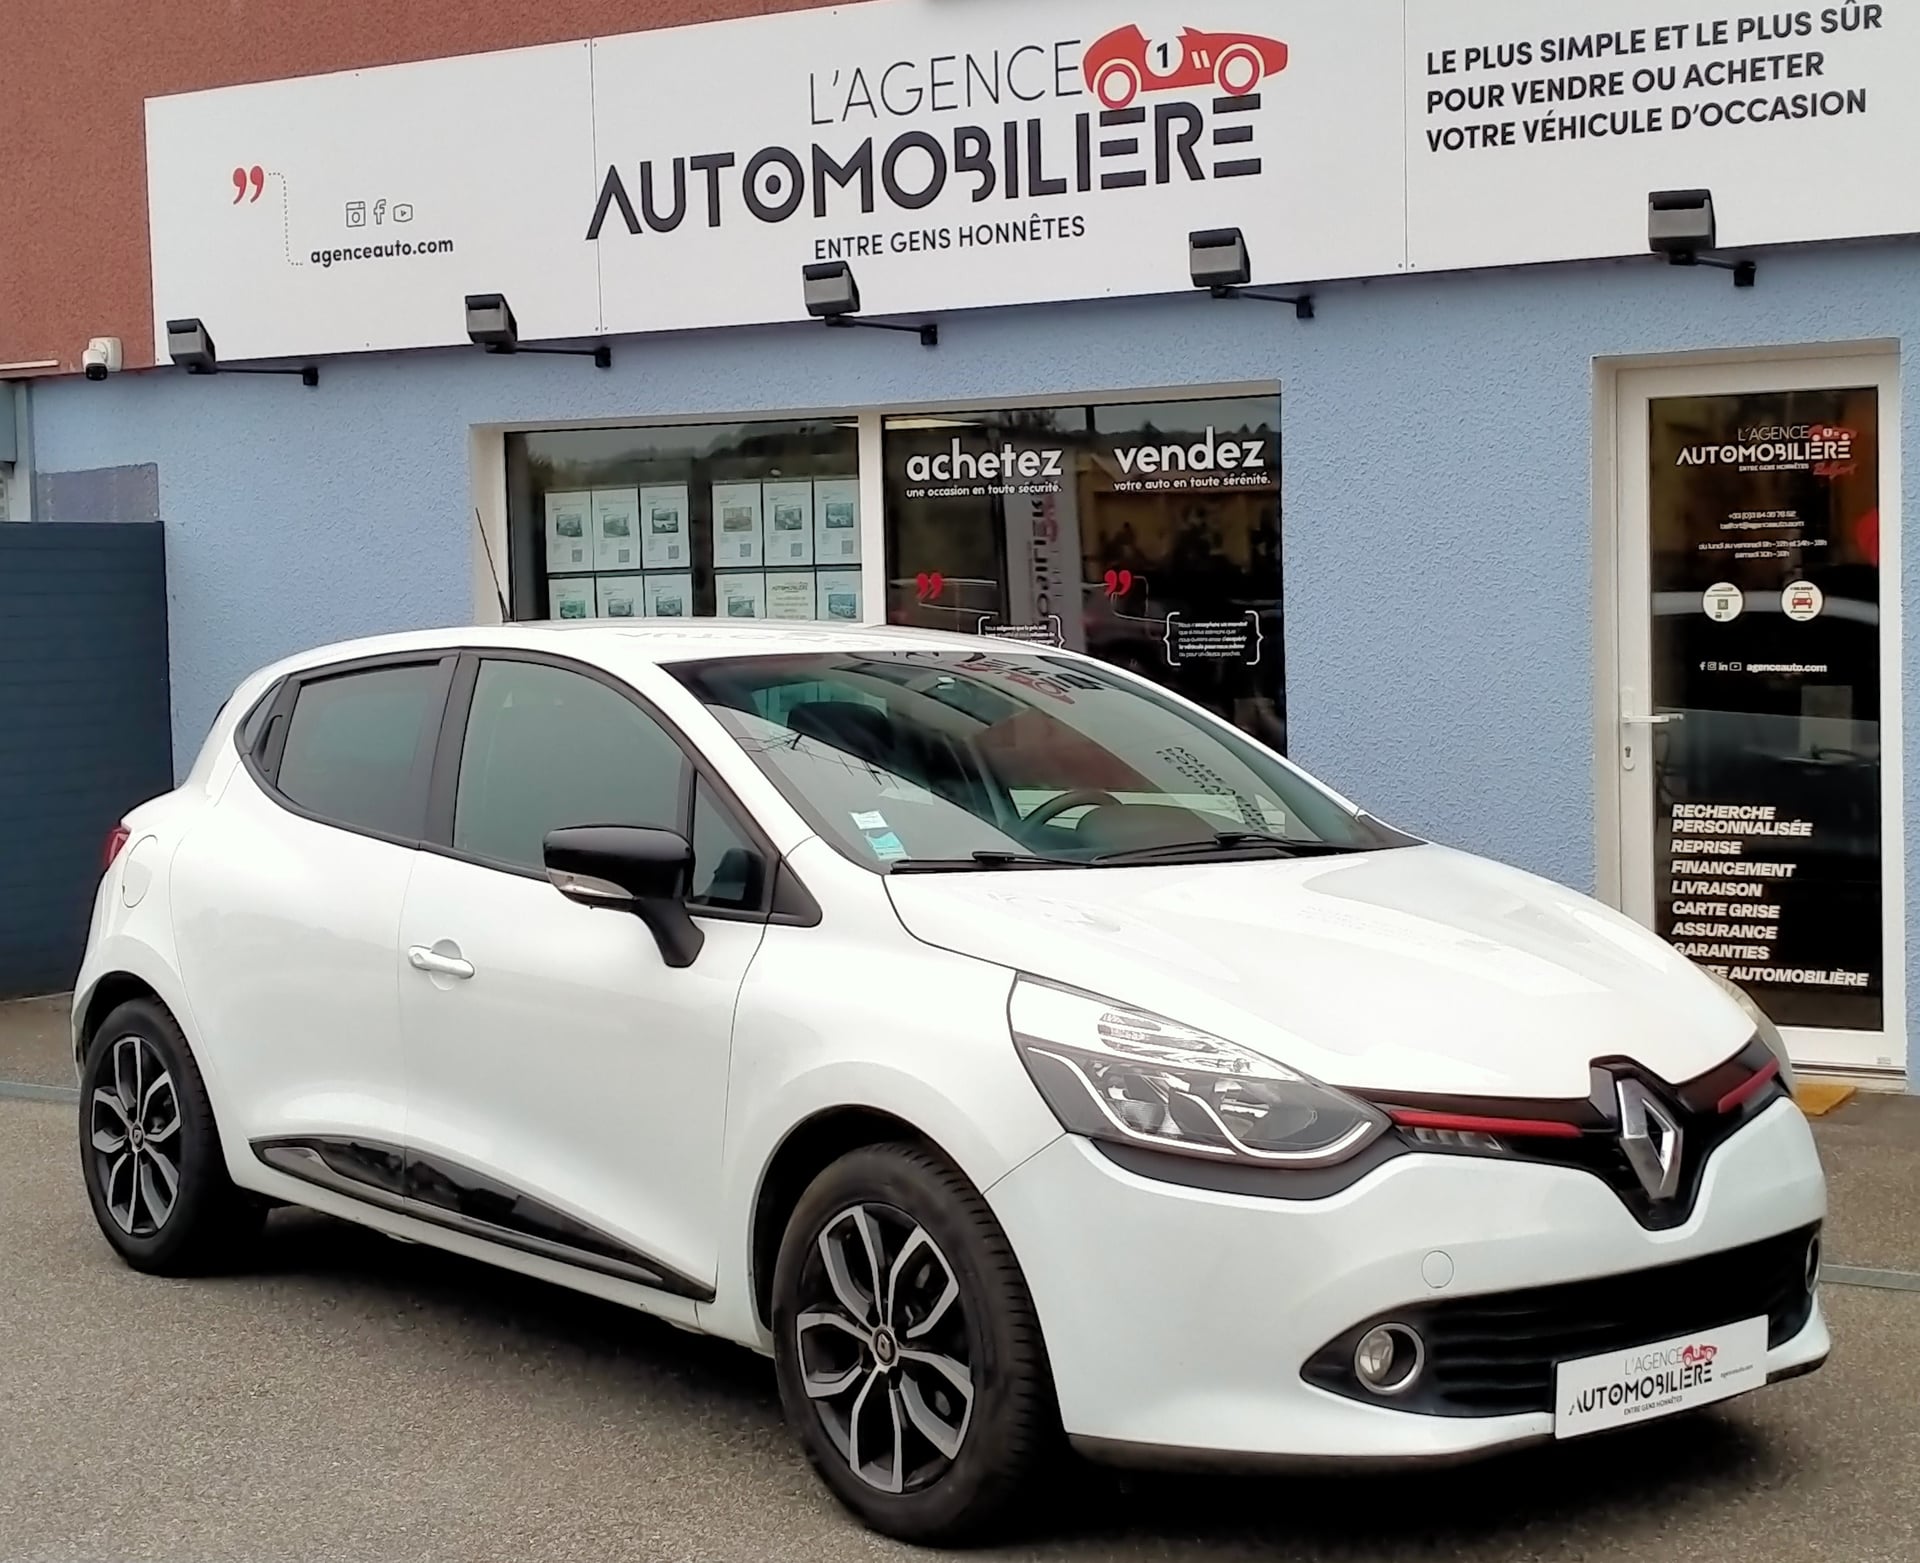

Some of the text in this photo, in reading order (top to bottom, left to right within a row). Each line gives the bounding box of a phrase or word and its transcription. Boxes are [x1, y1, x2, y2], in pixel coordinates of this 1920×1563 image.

[1427, 0, 1883, 75] LE PLUS SIMPLE ET LE PLUS SÛR
[809, 40, 1082, 125] L'AGENCE
[1427, 51, 1824, 114] POUR VENDRE OU ACHETER
[1426, 88, 1866, 152] VOTRE VÉHICULE D'OCCASION
[814, 215, 1086, 261] ENTRE GENS HONNÊTES
[310, 236, 454, 268] agenceauto.com
[1737, 425, 1810, 442] L'AGENCE
[906, 437, 1063, 481] achetez
[1113, 425, 1265, 474] vendez
[906, 481, 1062, 497] une occasion en toute sécurité.
[1113, 472, 1271, 491] votre auto en toute sérénité.
[1672, 804, 1776, 820] RECHERCHE
[1672, 819, 1813, 837] PERSONNALISÉE
[1671, 839, 1742, 855] REPRISE
[1671, 860, 1797, 877] FINANCEMENT
[1671, 881, 1763, 897] LIVRAISON
[1672, 901, 1781, 919] CARTE GRISE
[1671, 922, 1778, 939] ASSURANCE
[1673, 942, 1770, 960] GARANTIES
[1729, 966, 1869, 987] AUTOMOBILIÈRE
[1624, 1346, 1684, 1376] L'AGENCE
